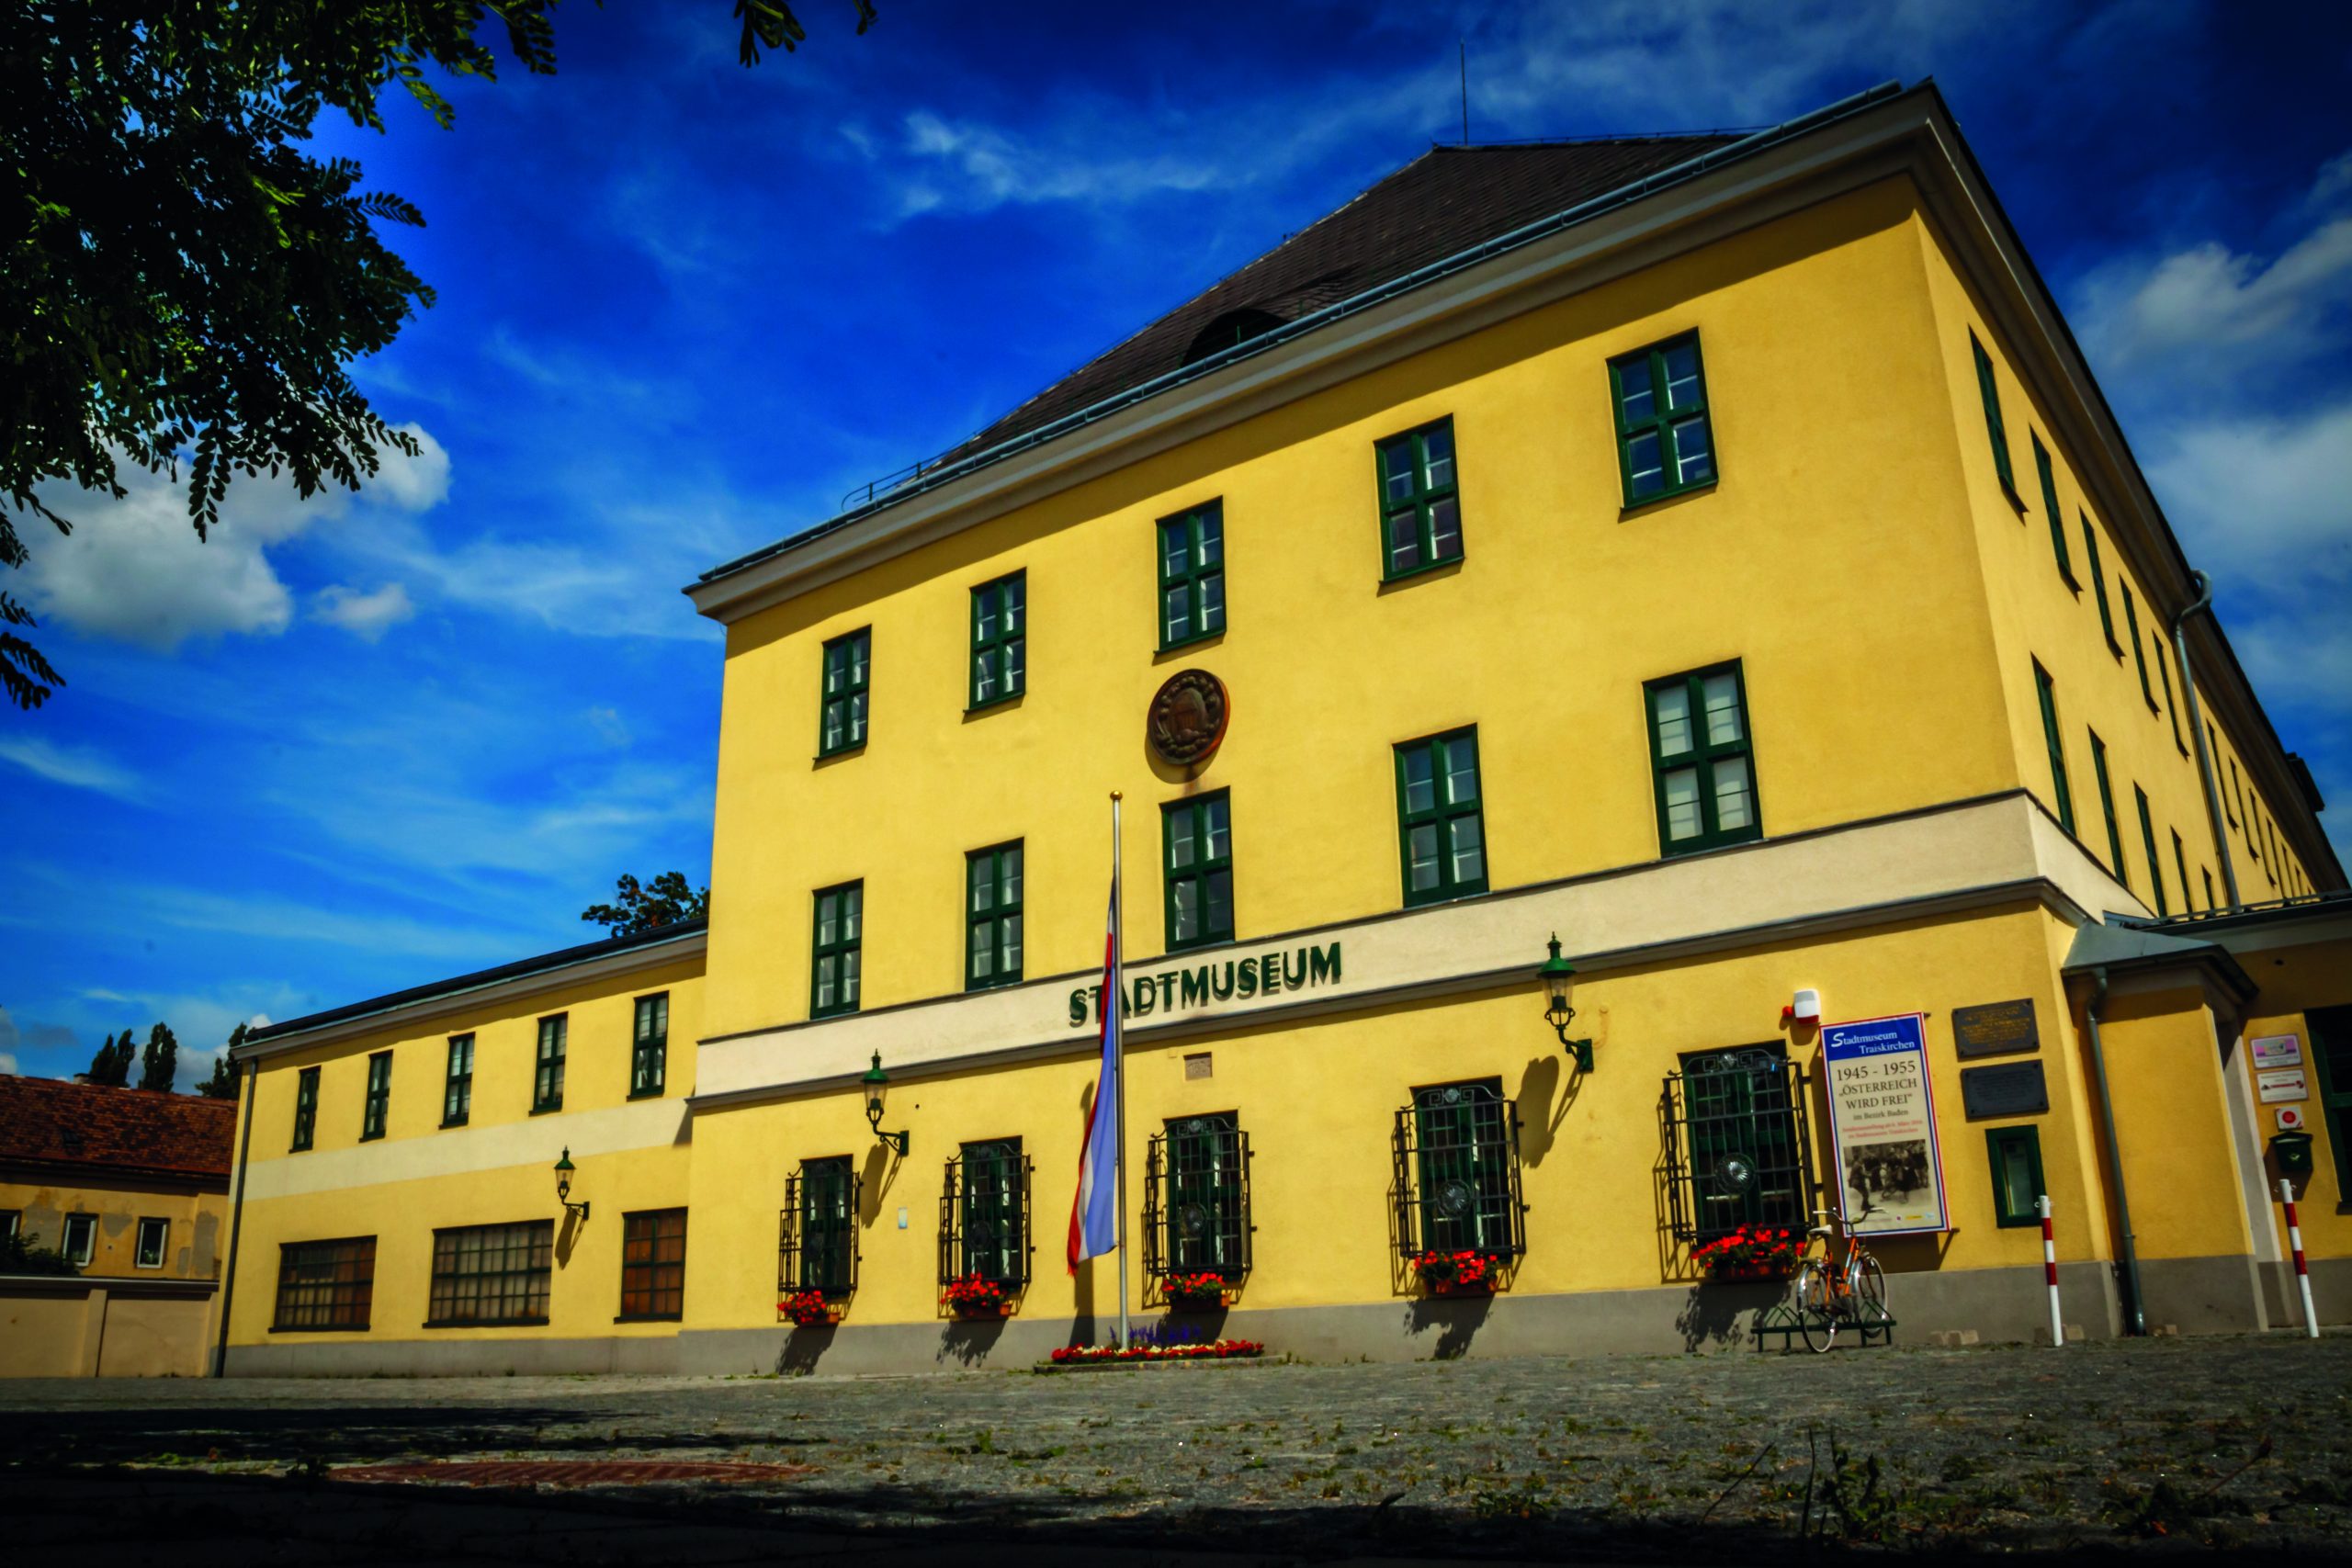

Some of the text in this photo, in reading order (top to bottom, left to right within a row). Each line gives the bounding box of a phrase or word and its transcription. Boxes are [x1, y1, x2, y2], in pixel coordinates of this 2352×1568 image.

[1831, 1032, 1897, 1047] Stadtmuseum
[1859, 1041, 1916, 1055] Traiskirchen
[1838, 1066, 1869, 1081] 1945
[1883, 1060, 1916, 1076] 1955
[1845, 1097, 1879, 1110] WIRD
